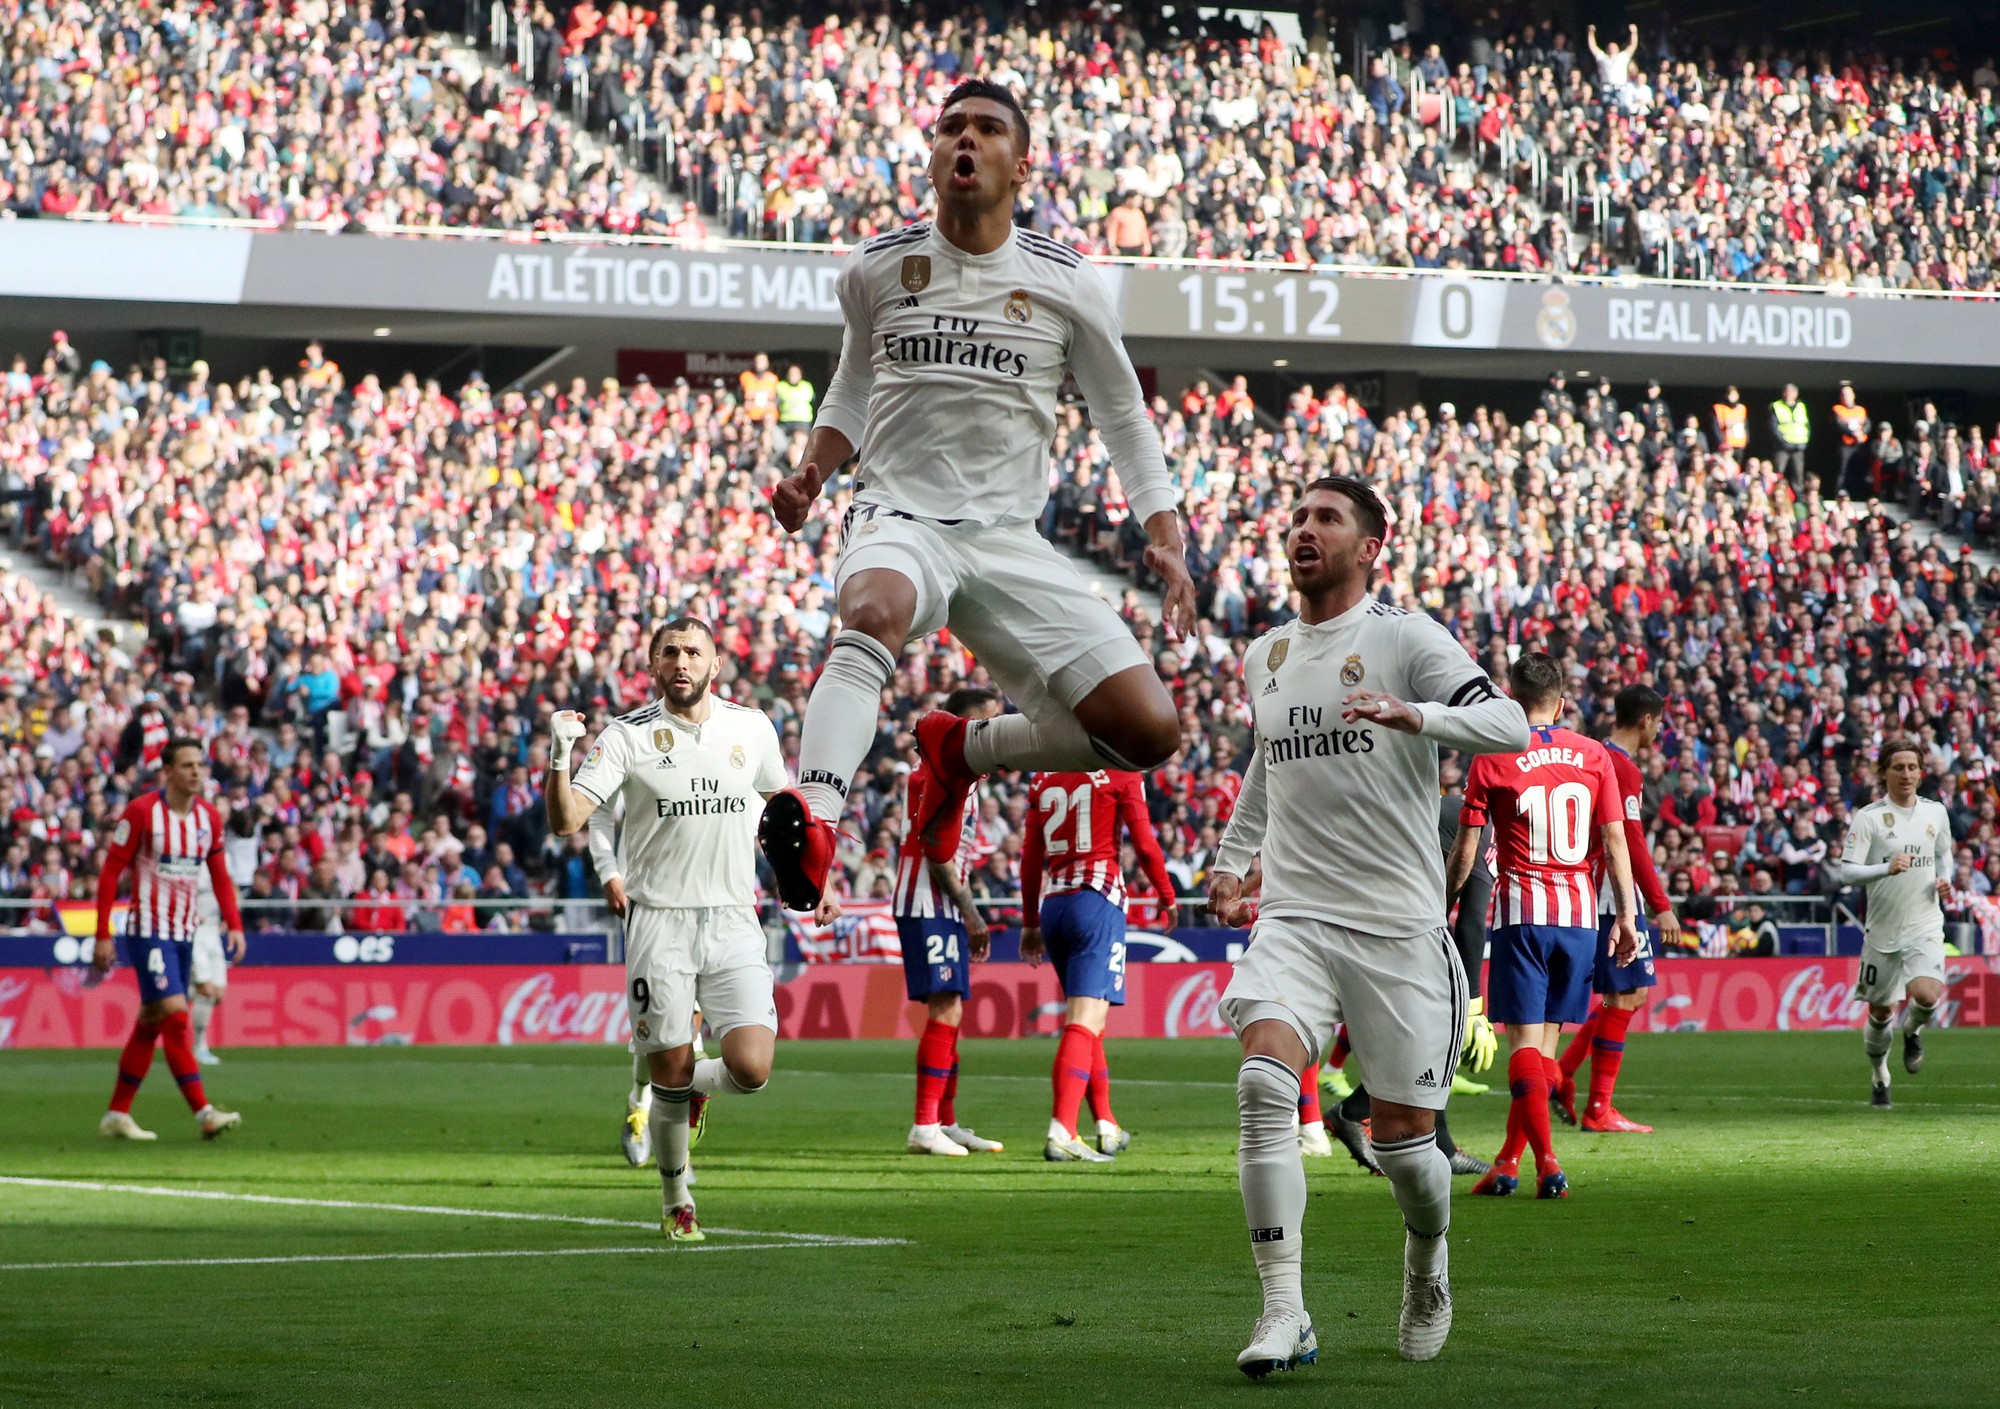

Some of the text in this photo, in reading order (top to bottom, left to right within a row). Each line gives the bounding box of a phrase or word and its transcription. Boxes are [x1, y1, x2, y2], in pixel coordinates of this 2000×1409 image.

[488, 248, 841, 313] ATLÉTICO DE MAD
[1178, 274, 1341, 336] 15:12
[1440, 284, 1473, 339] 0
[1608, 299, 1852, 348] REAL MADRID
[883, 332, 1028, 377] Emirates
[1289, 705, 1322, 728] Fly
[1515, 747, 1584, 773] CORREA
[690, 777, 719, 794] Fly
[802, 770, 849, 797] RMCF
[656, 794, 746, 818] Emirates
[1039, 783, 1092, 855] 21
[1516, 781, 1592, 866] 10
[1904, 844, 1921, 855] Fly
[147, 947, 166, 974] 4
[926, 934, 960, 965] 24
[1859, 961, 1878, 986] 10
[632, 977, 650, 1015] 9
